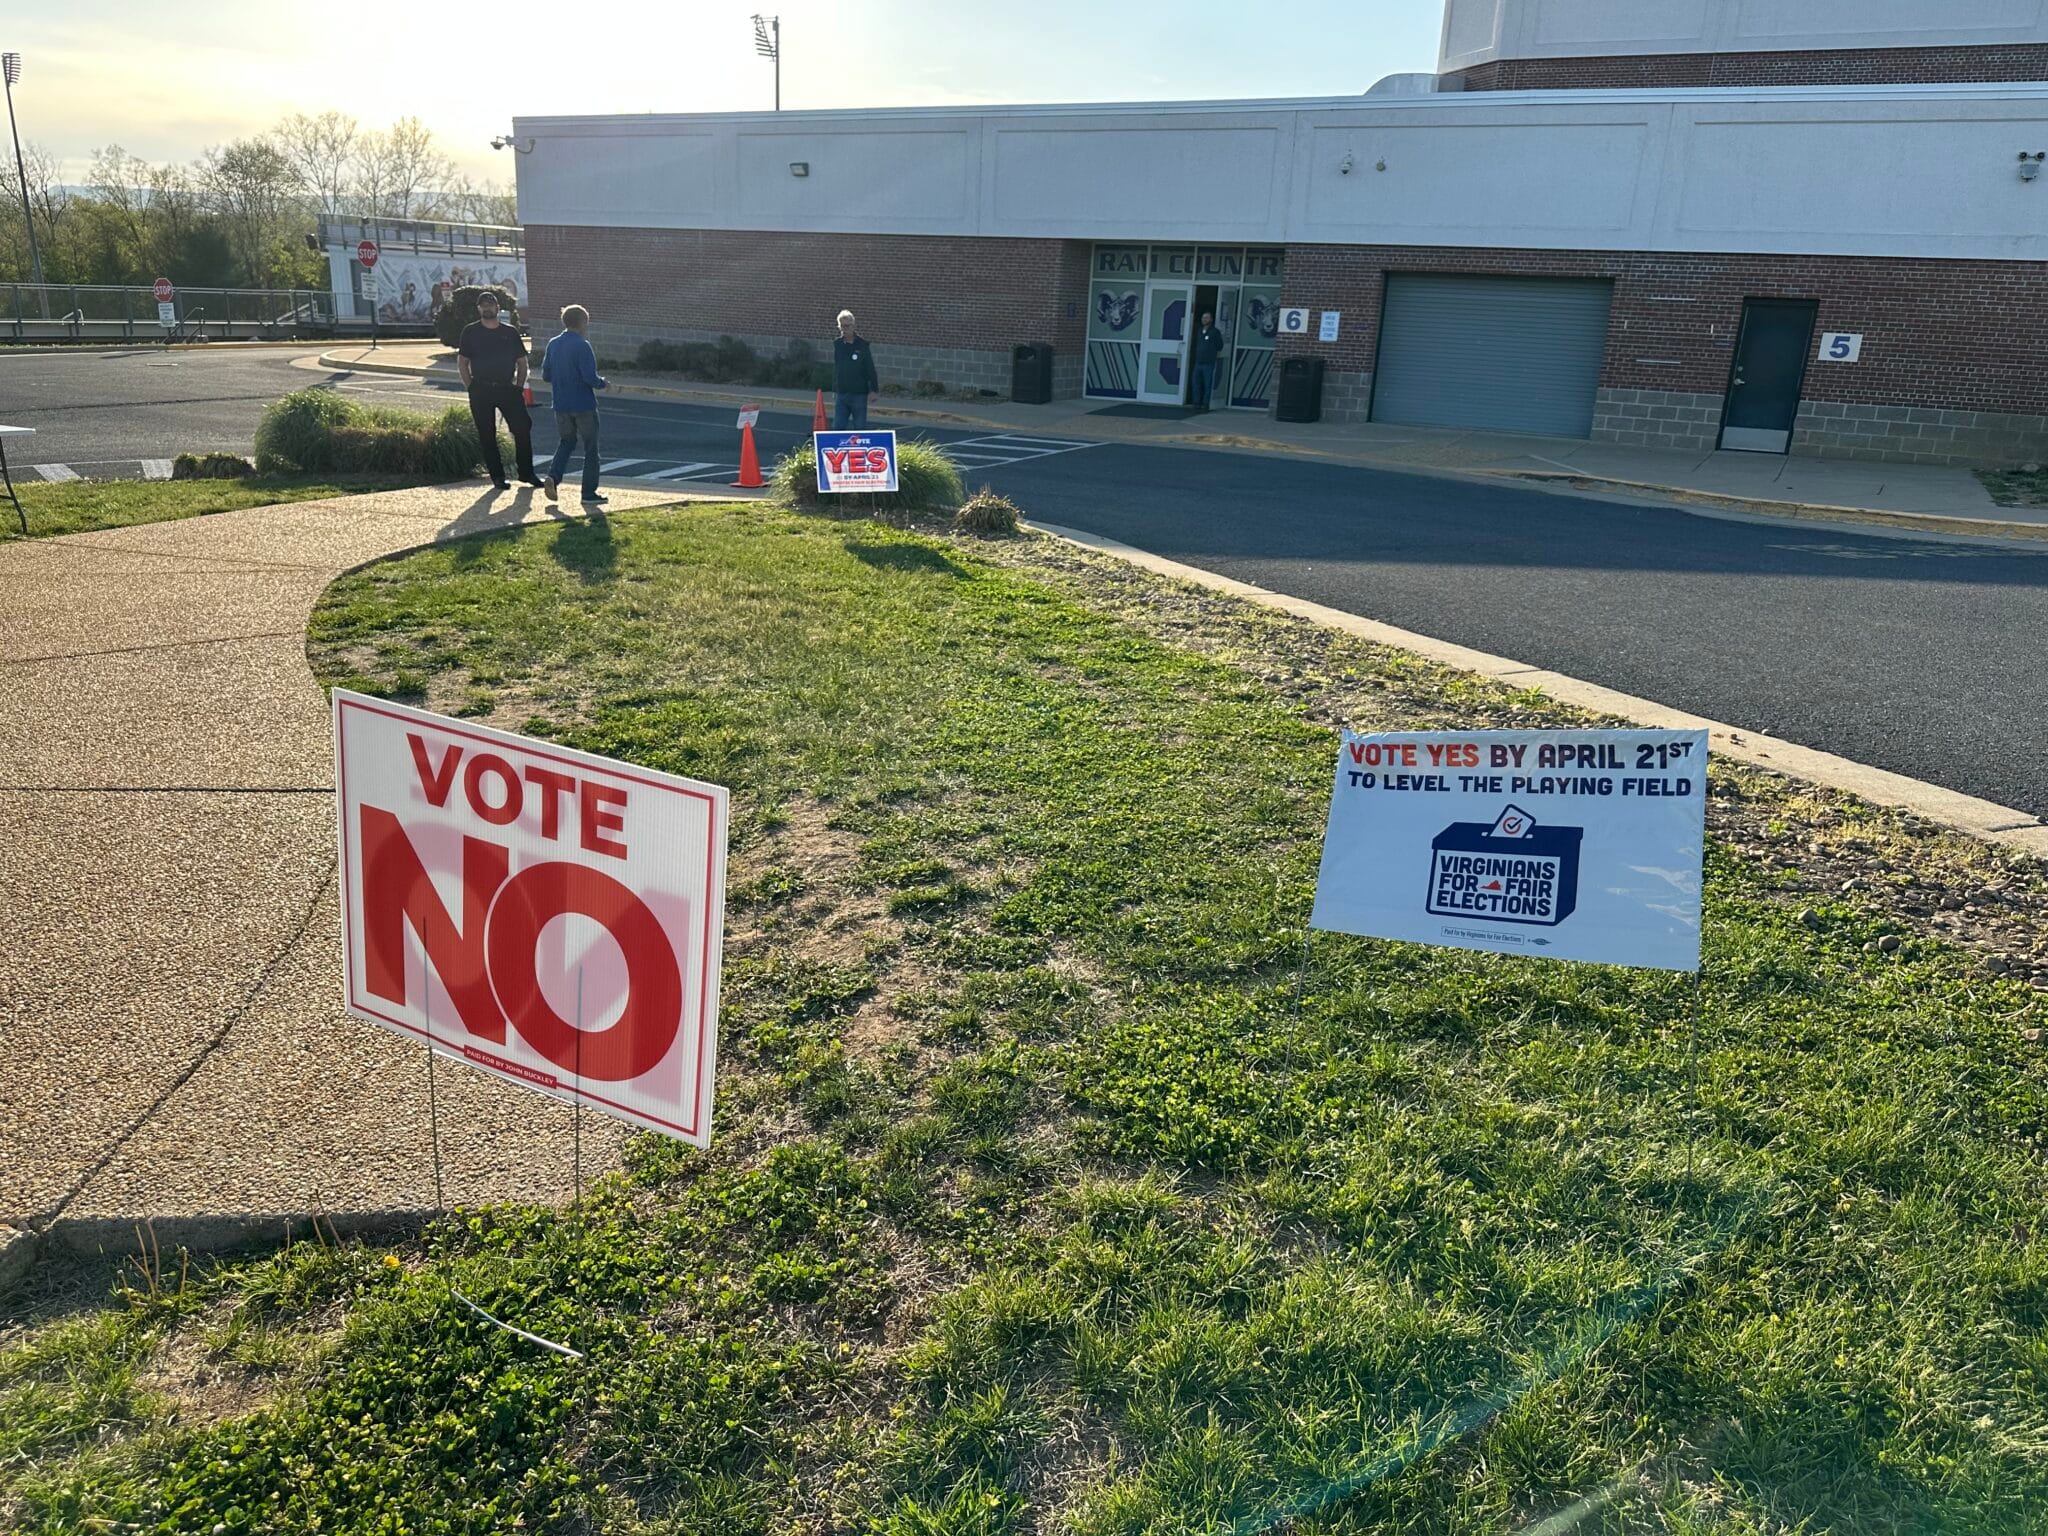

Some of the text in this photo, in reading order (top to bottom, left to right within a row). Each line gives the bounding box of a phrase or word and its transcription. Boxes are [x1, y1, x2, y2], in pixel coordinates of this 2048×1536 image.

[359, 248, 376, 259] STOP
[1099, 252, 1284, 275] RAM COUNTR
[155, 285, 171, 295] STOP
[1286, 310, 1302, 330] 6
[1829, 336, 1851, 359] 5
[824, 449, 888, 473] YES
[1349, 741, 1693, 769] VOTE YES BY APRIL 21ST
[1347, 770, 1691, 797] TO LEVEL THE PLAYING FIELD
[406, 733, 628, 860] VOTE
[1440, 855, 1555, 880] VIRGINIANS
[1438, 872, 1552, 898] FOR FAIR
[1436, 890, 1551, 917] ELECTIONS
[360, 803, 683, 1082] NO
[1502, 934, 1521, 943] Elections
[466, 1049, 482, 1060] PAID
[482, 1055, 495, 1064] FOR
[505, 1063, 523, 1074] JOHN
[523, 1070, 554, 1084] BUCKLEY
